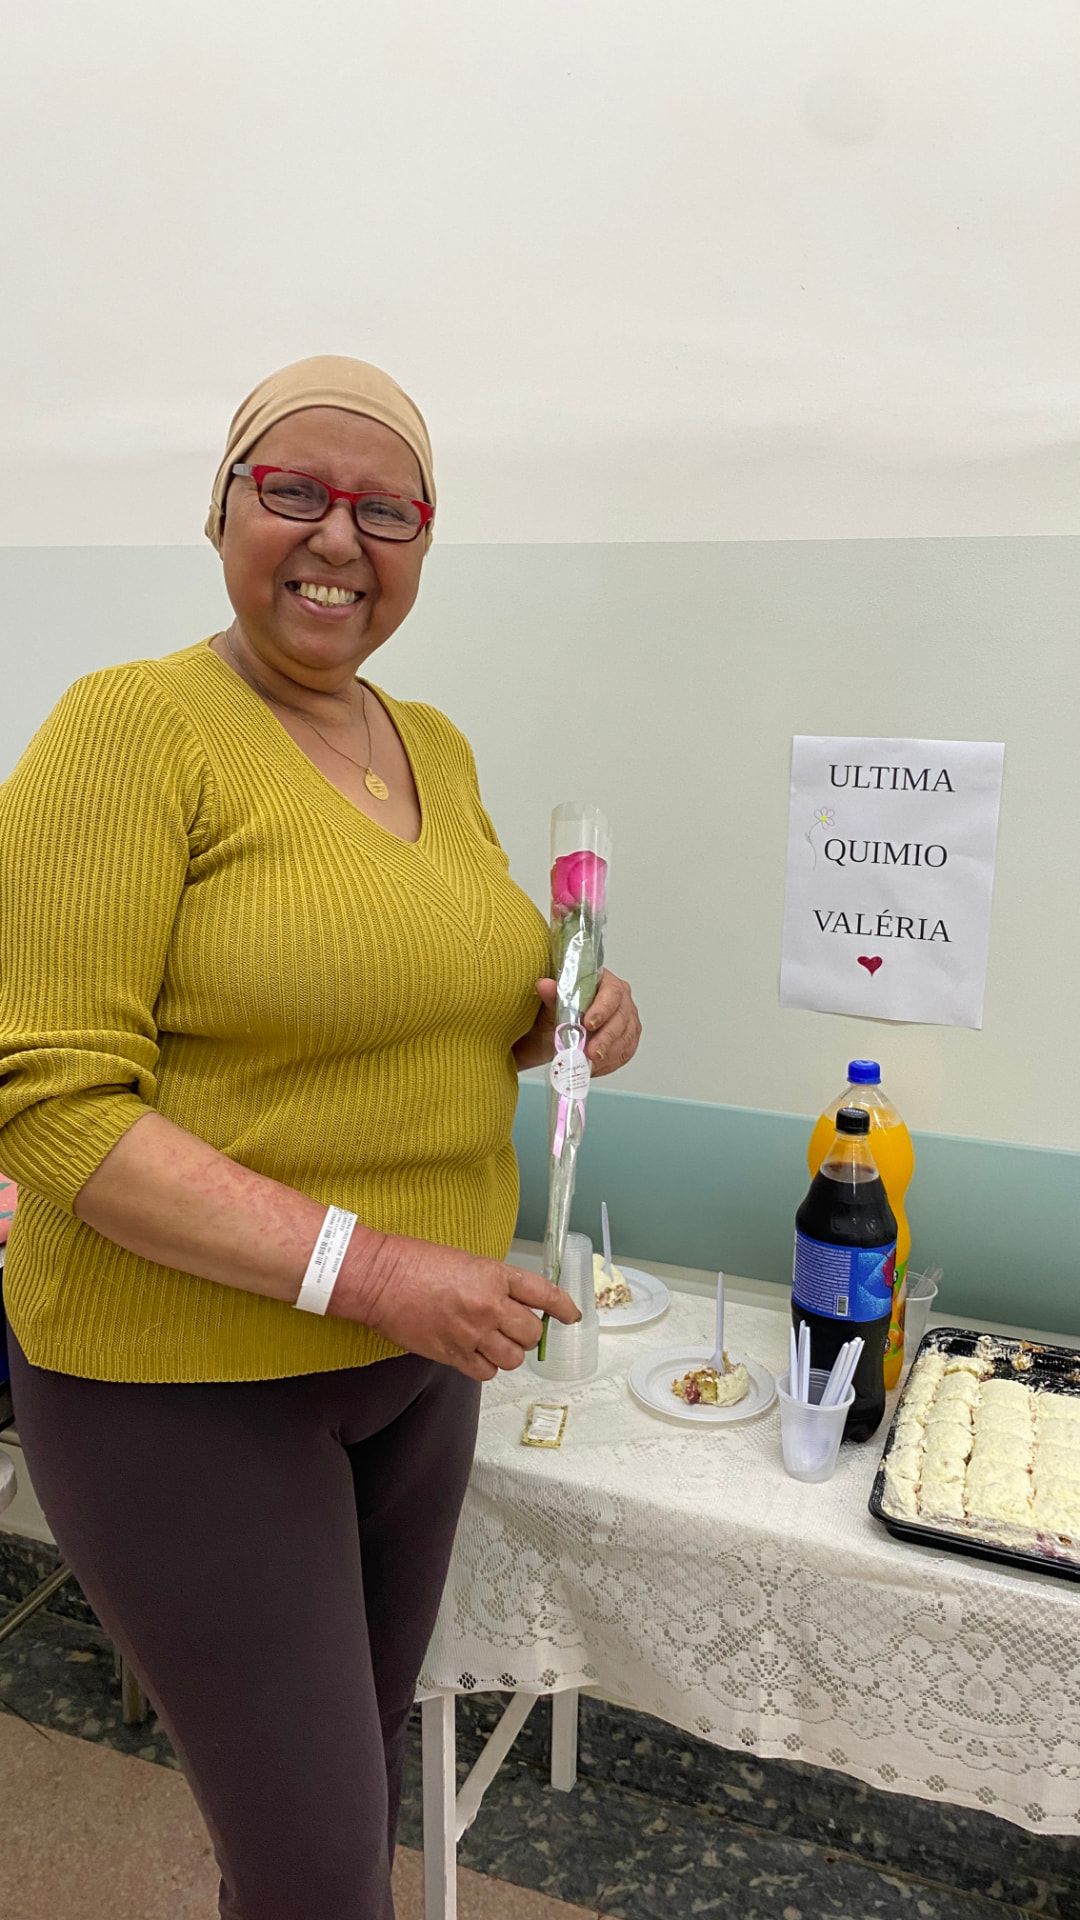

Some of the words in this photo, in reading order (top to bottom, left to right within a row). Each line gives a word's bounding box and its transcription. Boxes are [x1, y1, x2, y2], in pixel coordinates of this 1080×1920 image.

[829, 764, 956, 793] ULTIMA
[824, 838, 948, 868] QUIMIO
[812, 909, 953, 943] VALÉRIA
